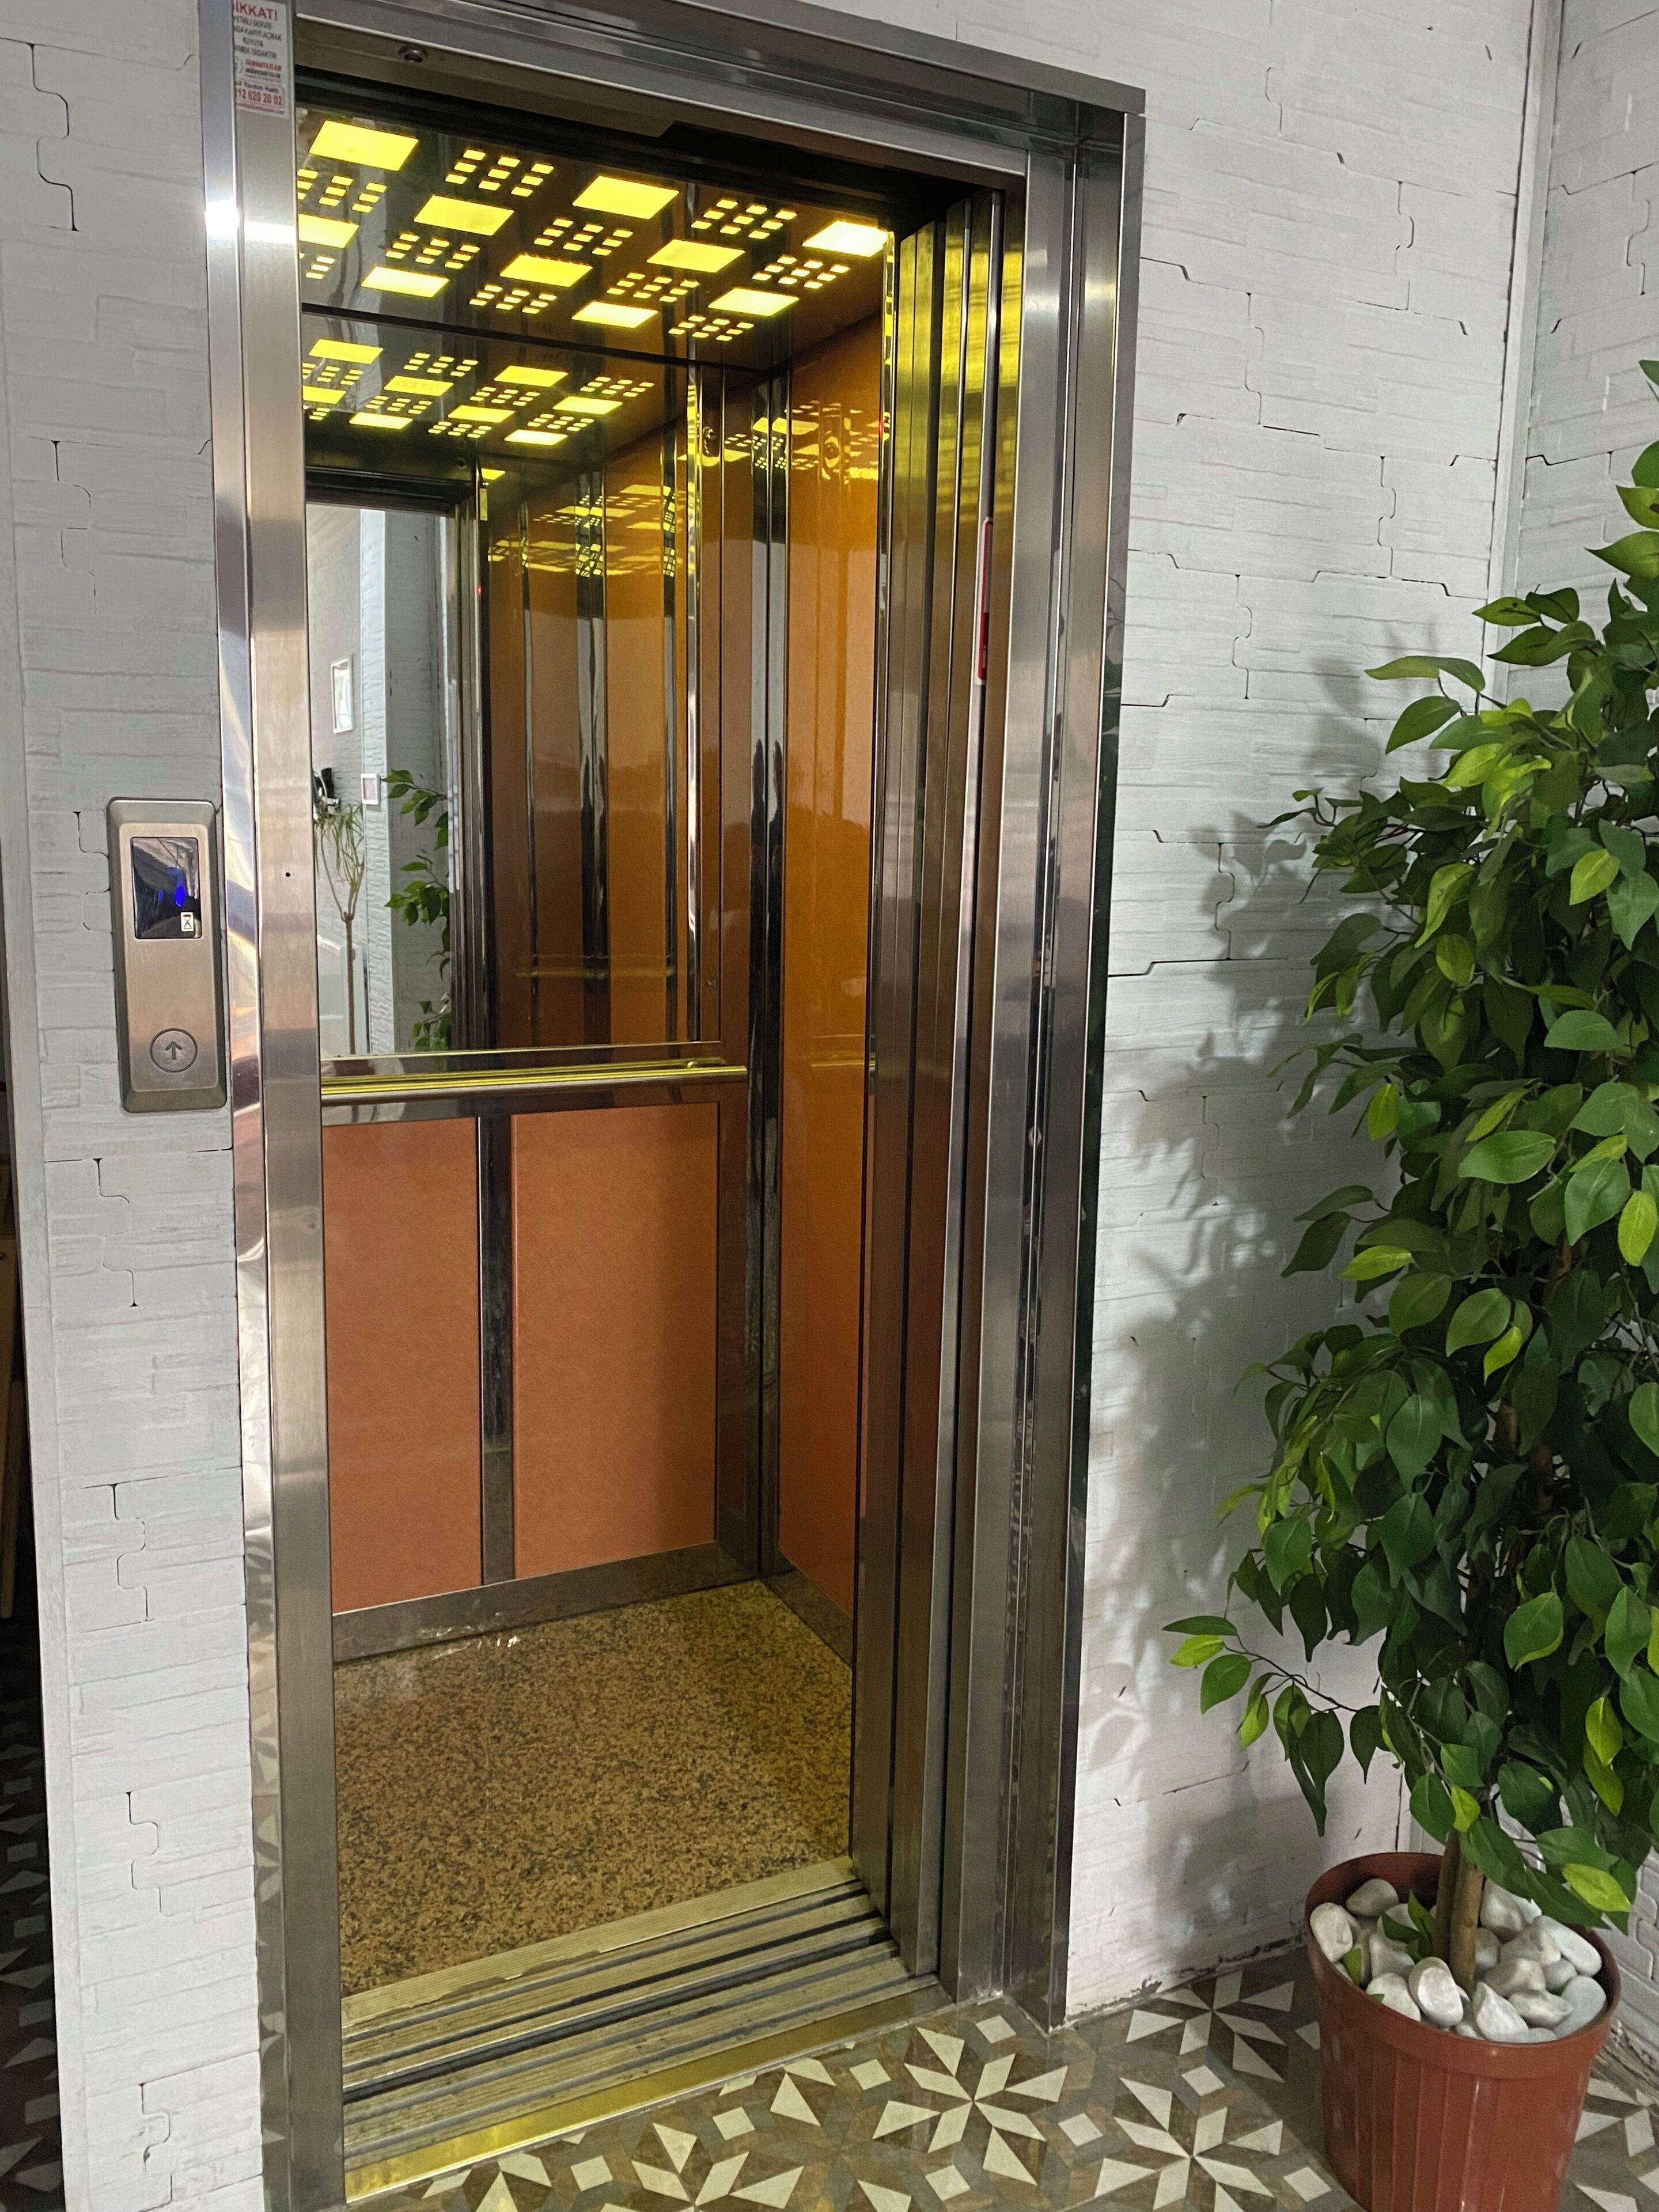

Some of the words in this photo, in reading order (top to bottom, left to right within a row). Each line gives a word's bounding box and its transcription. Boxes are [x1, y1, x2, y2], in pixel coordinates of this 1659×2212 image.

[233, 0, 278, 21] İKKAT!
[248, 90, 262, 102] 620
[263, 92, 272, 104] 20
[273, 94, 283, 106] 02
